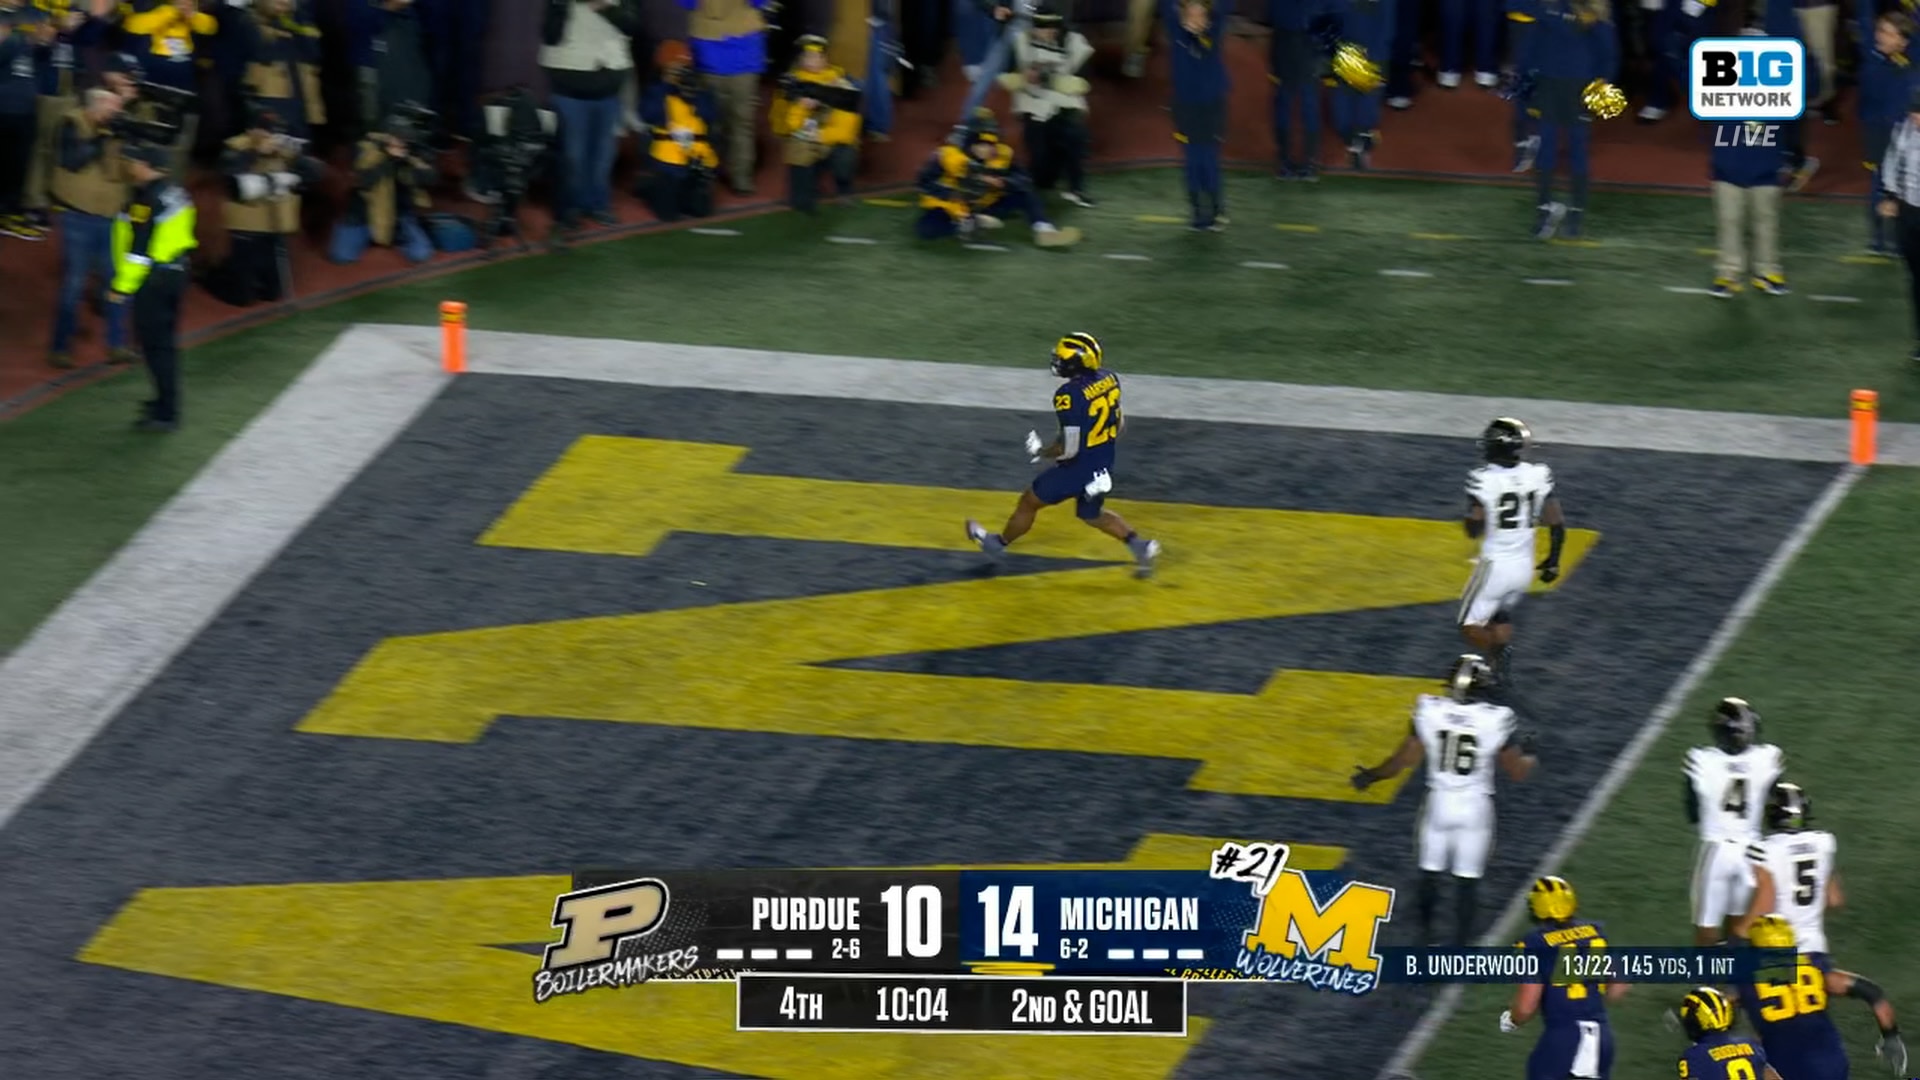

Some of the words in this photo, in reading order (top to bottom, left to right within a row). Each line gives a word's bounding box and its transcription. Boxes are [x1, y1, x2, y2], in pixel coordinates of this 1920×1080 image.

[1055, 394, 1071, 410] 23
[1087, 387, 1122, 448] 23
[1498, 492, 1536, 529] 21
[1436, 729, 1477, 776] 16
[1721, 777, 1748, 819] 4
[1794, 859, 1816, 906] 5
[1753, 966, 1826, 1021] 58
